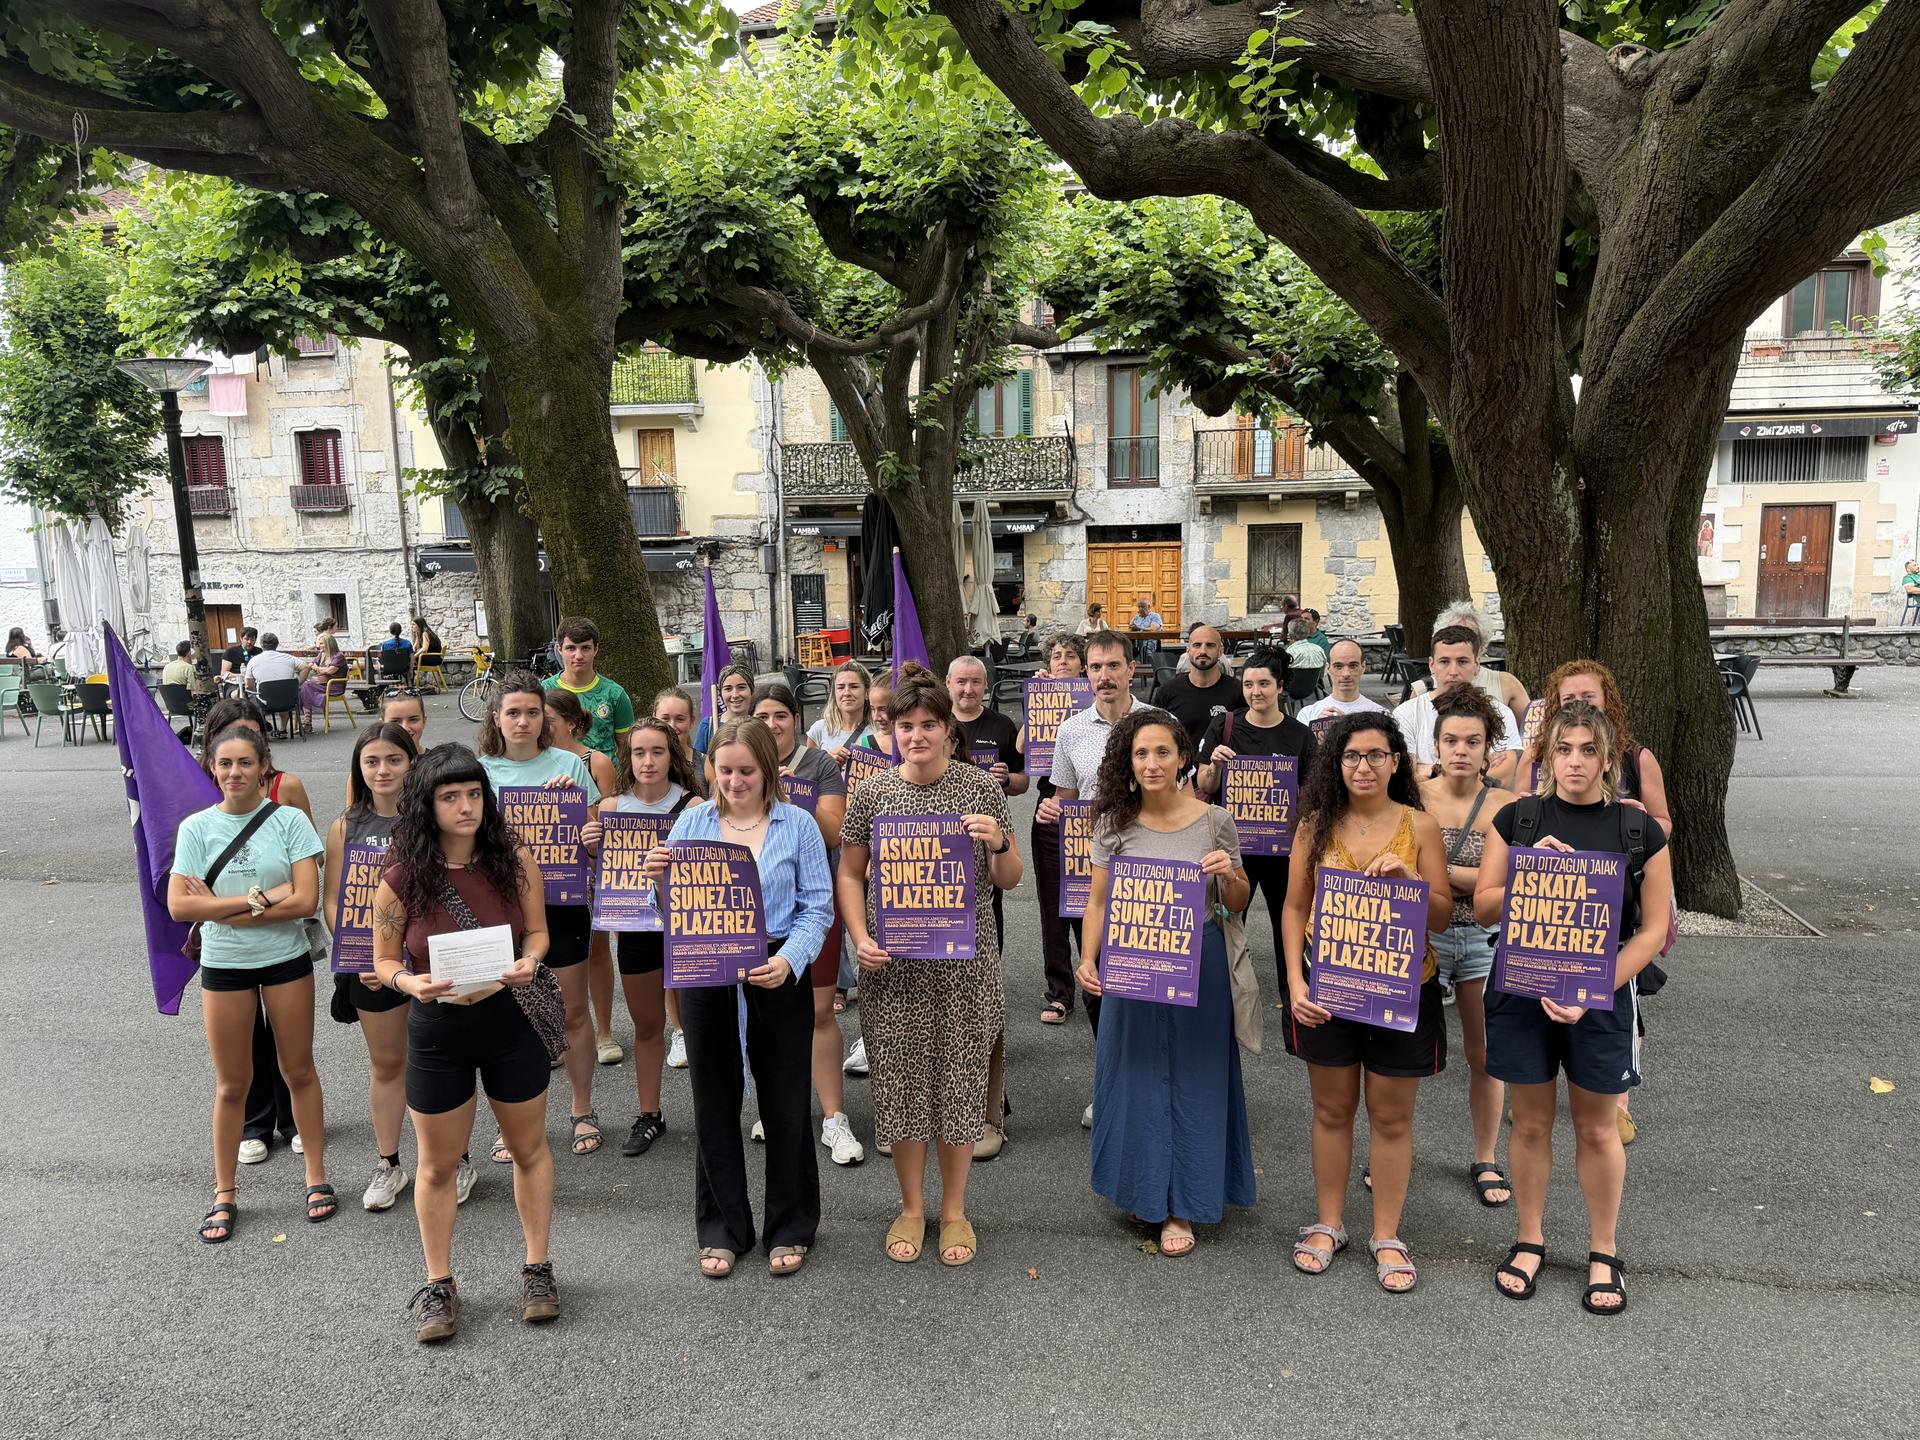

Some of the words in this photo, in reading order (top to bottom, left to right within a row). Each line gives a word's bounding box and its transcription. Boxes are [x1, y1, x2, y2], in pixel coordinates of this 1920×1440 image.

[1132, 530, 1138, 539] 5
[1028, 682, 1039, 692] BIZI
[1042, 682, 1070, 692] DITZAGUN
[1072, 682, 1090, 692] JAIAK
[1028, 692, 1078, 708] ASKATA-
[1028, 709, 1067, 725] SUNEZ
[1028, 726, 1056, 742] PLAZ
[852, 749, 863, 760] BIZI
[864, 752, 892, 769] DITZAGUN
[1227, 760, 1240, 770] BIZI
[1242, 760, 1272, 771] DITZAGUN
[1274, 761, 1293, 772] JAIAK
[849, 760, 880, 780] ASKA
[1227, 770, 1280, 788] ASKATA-
[504, 792, 519, 804] BIZI
[521, 792, 558, 804] DITZAGUN
[560, 792, 582, 804] JAIAK
[793, 782, 812, 797] JAIAK
[1226, 787, 1268, 804] SUNEZ
[1271, 789, 1290, 805] ETA
[504, 804, 568, 824] ASKATA-
[1064, 805, 1078, 817] BIZI
[604, 818, 618, 829] BIZI
[621, 818, 657, 829] DITZAGUN
[659, 819, 673, 830] JAIA
[880, 823, 895, 836] BIZI
[898, 822, 939, 836] DITZAGUN
[942, 821, 966, 836] JAIAK
[509, 825, 553, 844] UNEZ
[558, 825, 580, 844] ETA
[603, 830, 666, 849] ASKATA-
[531, 845, 578, 864] ZEREZ
[669, 847, 684, 860] BIZI
[687, 847, 727, 860] DITZAGUN
[729, 848, 750, 863] JAIAK
[880, 837, 950, 860] ASKATA-
[1064, 837, 1091, 857] SUN
[350, 850, 366, 862] BIZI
[368, 851, 387, 865] DITZ
[602, 850, 646, 870] SUNE
[1515, 855, 1535, 870] BIZI
[1538, 856, 1587, 873] DITZAGUN
[1589, 859, 1618, 875] JAIAK
[601, 870, 653, 890] PLAZE
[670, 862, 739, 885] ASKATA-
[880, 862, 936, 884] SUNEZ
[940, 861, 966, 884] ETA
[1114, 862, 1131, 876] BIZI
[1132, 863, 1174, 880] DITZAGUN
[1176, 867, 1201, 883] JAIAK
[1111, 877, 1183, 904] ASKATA-
[1324, 874, 1342, 890] BIZI
[1344, 878, 1391, 899] DITZAGUN
[1393, 885, 1422, 903] JAIAK
[1511, 871, 1597, 900] ASKATA-
[344, 886, 378, 907] SUN
[670, 886, 726, 911] SUNEZ
[731, 886, 756, 909] ETA
[881, 886, 964, 909] PLAZEREZ
[1110, 900, 1166, 927] SUNEZ
[1169, 906, 1194, 931] ETA
[1321, 890, 1401, 924] ASKATA-
[1509, 896, 1576, 925] SUNEZ
[1580, 902, 1610, 928] ETA
[670, 911, 756, 936] PLAZEREZ
[1108, 924, 1192, 955] PLAZEREZ
[1320, 915, 1381, 947] SUNEZ
[1386, 926, 1414, 953] ETA
[1506, 921, 1606, 955] PLAZEREZ
[1318, 940, 1411, 979] PLAZEREZ
